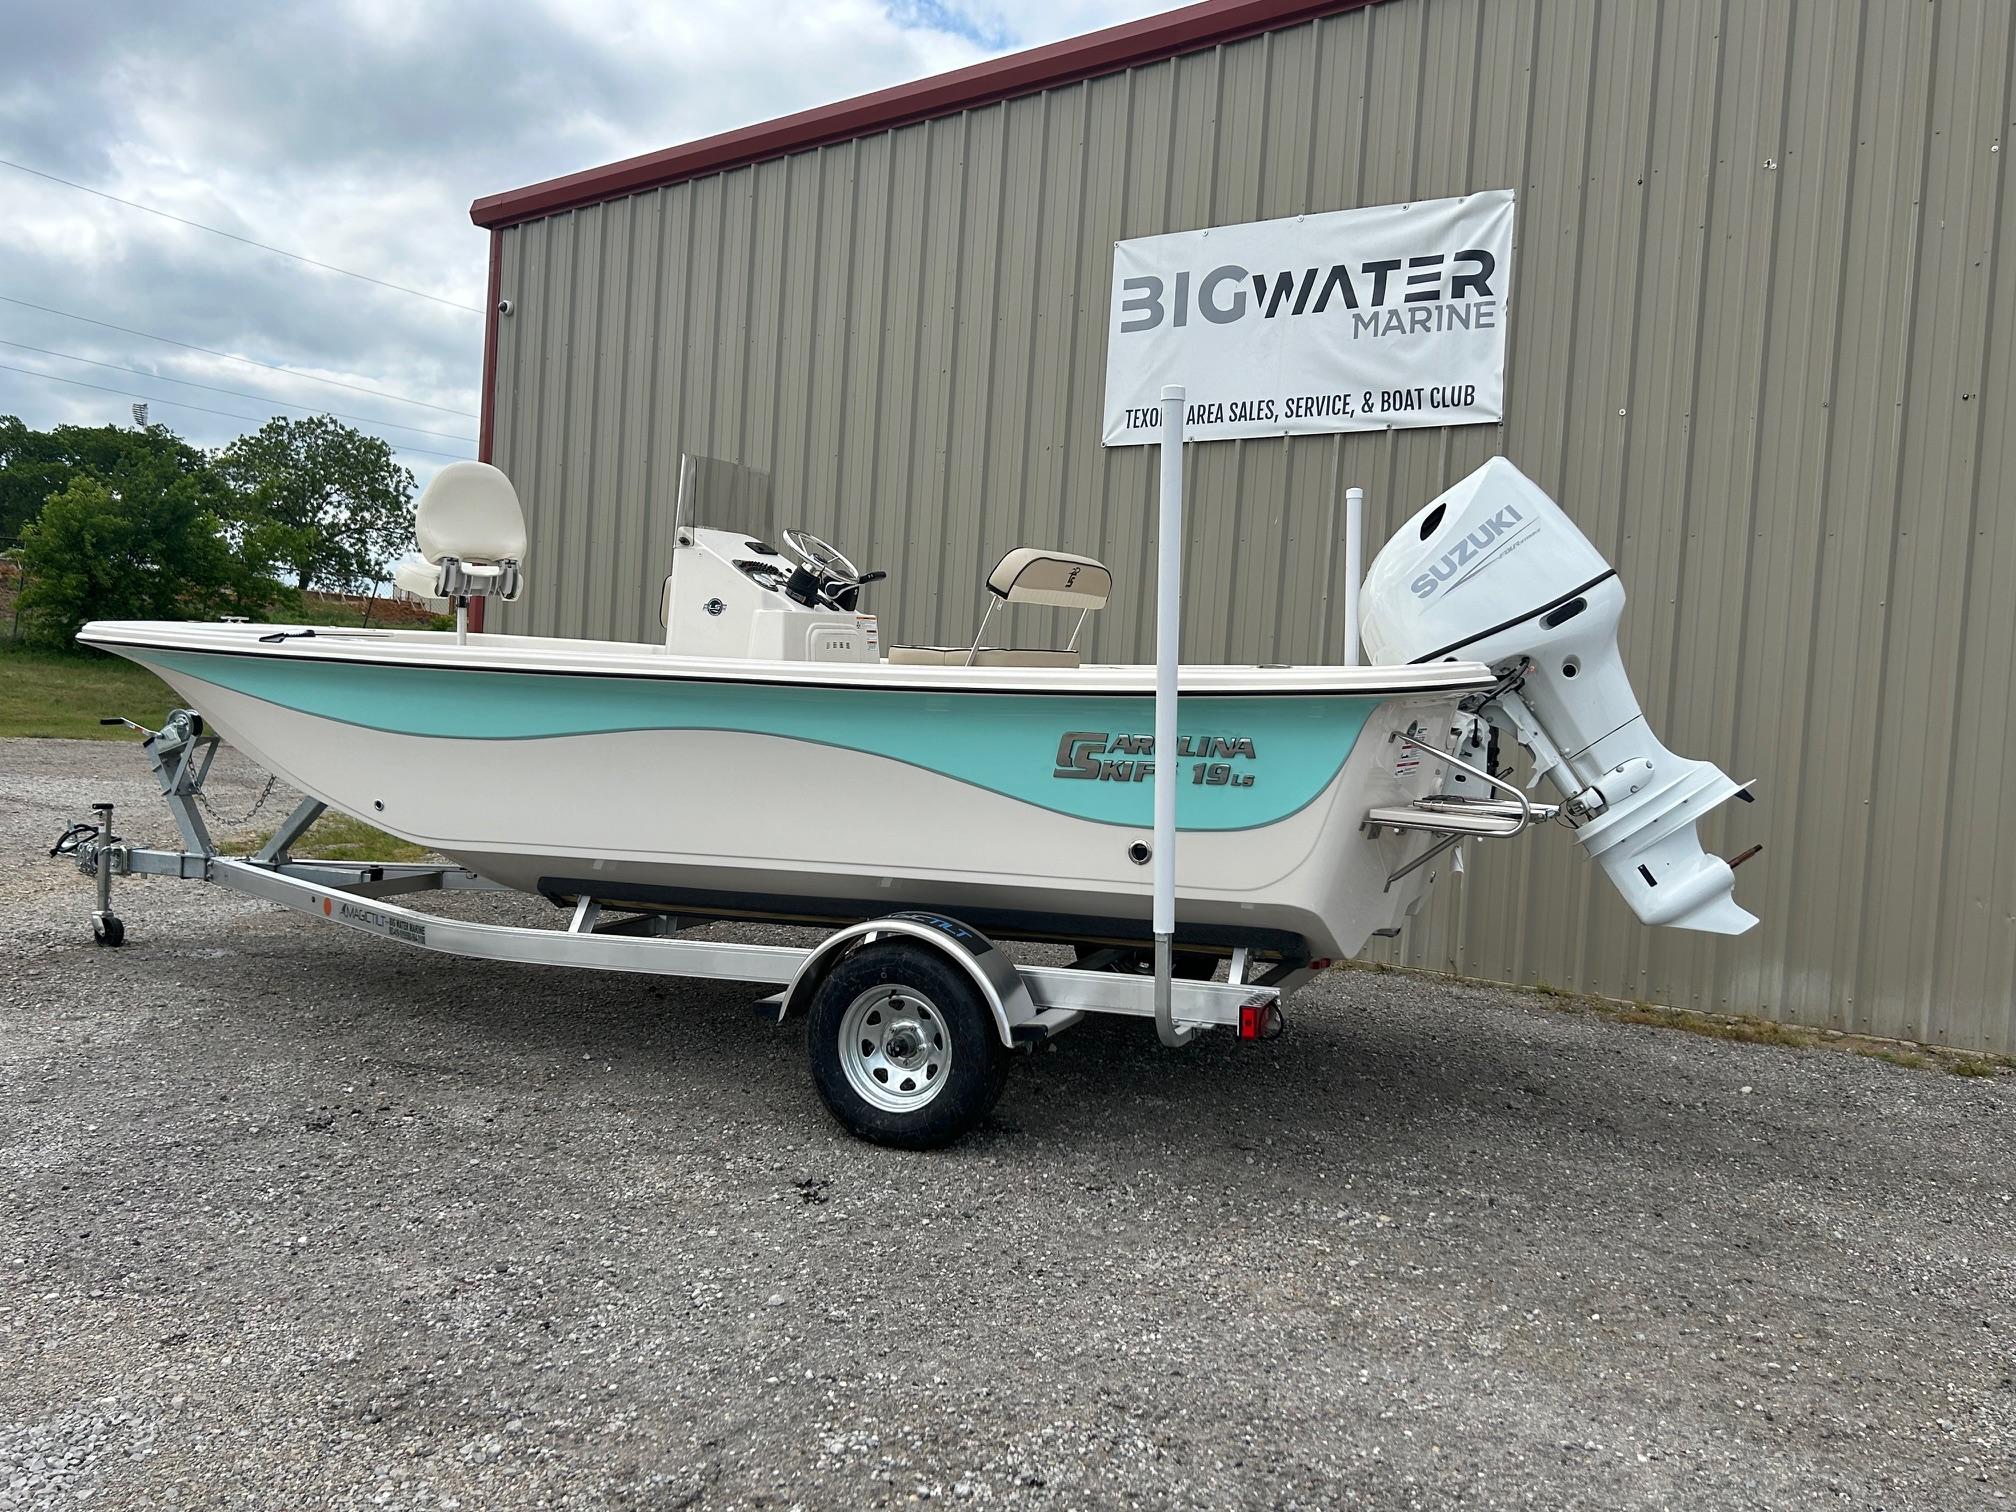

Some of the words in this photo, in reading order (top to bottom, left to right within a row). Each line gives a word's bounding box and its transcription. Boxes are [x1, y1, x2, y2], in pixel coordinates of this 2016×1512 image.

[1353, 300, 1497, 340] MARINE
[1125, 407, 1163, 429] TEXO
[1186, 402, 1224, 426] AREA
[1228, 399, 1279, 423] SALES,
[1284, 393, 1355, 419] SERVICE,
[1361, 390, 1375, 413] &
[1380, 387, 1425, 413] BOAT
[1430, 384, 1476, 409] CLUB
[1410, 504, 1523, 599] SUZUKI
[1056, 731, 1257, 768] CARLINA
